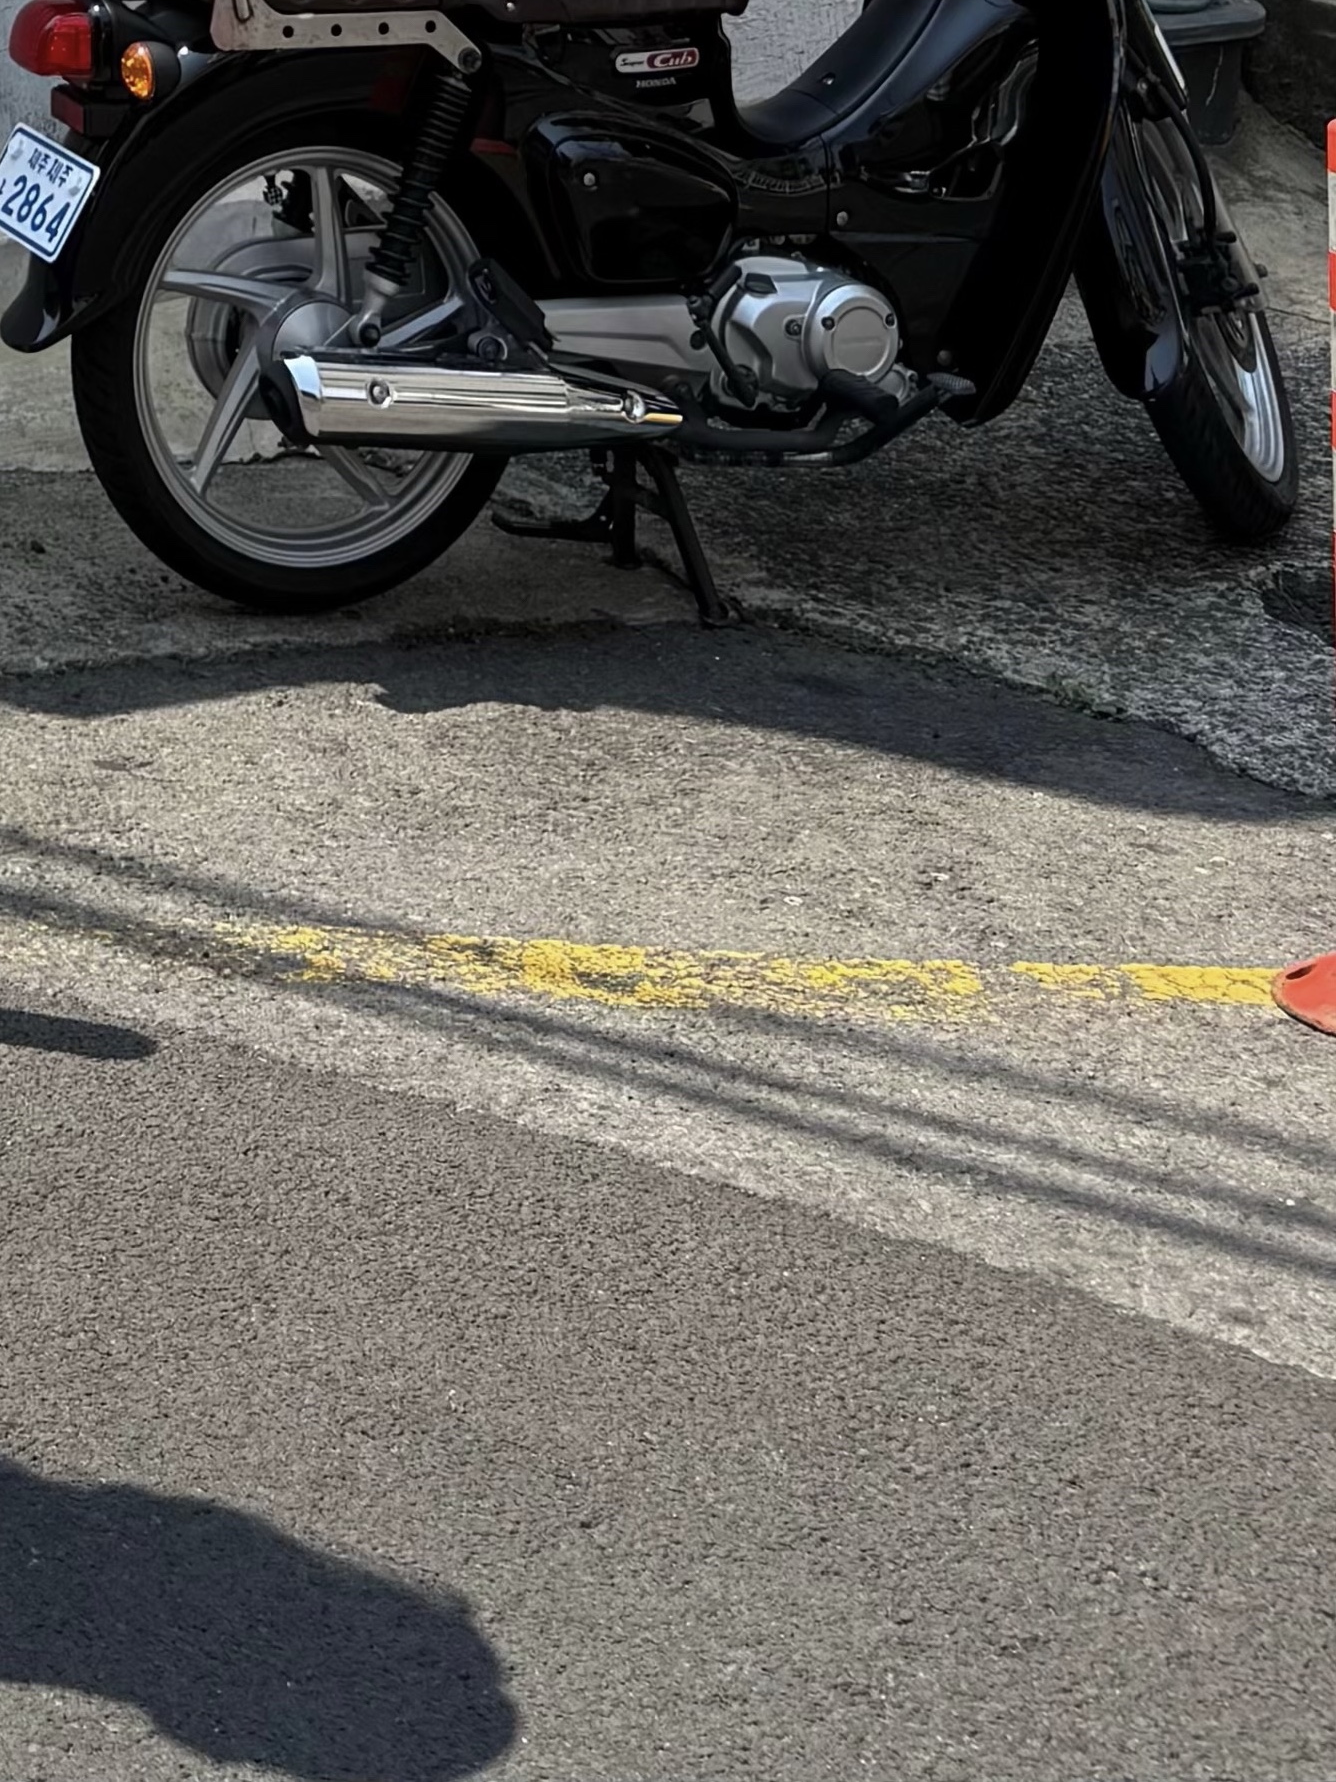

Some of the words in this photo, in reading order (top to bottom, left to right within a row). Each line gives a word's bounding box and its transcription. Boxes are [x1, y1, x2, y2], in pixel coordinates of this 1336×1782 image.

[653, 51, 693, 68] Cub
[635, 76, 678, 89] HONDA
[0, 174, 72, 244] 2864
